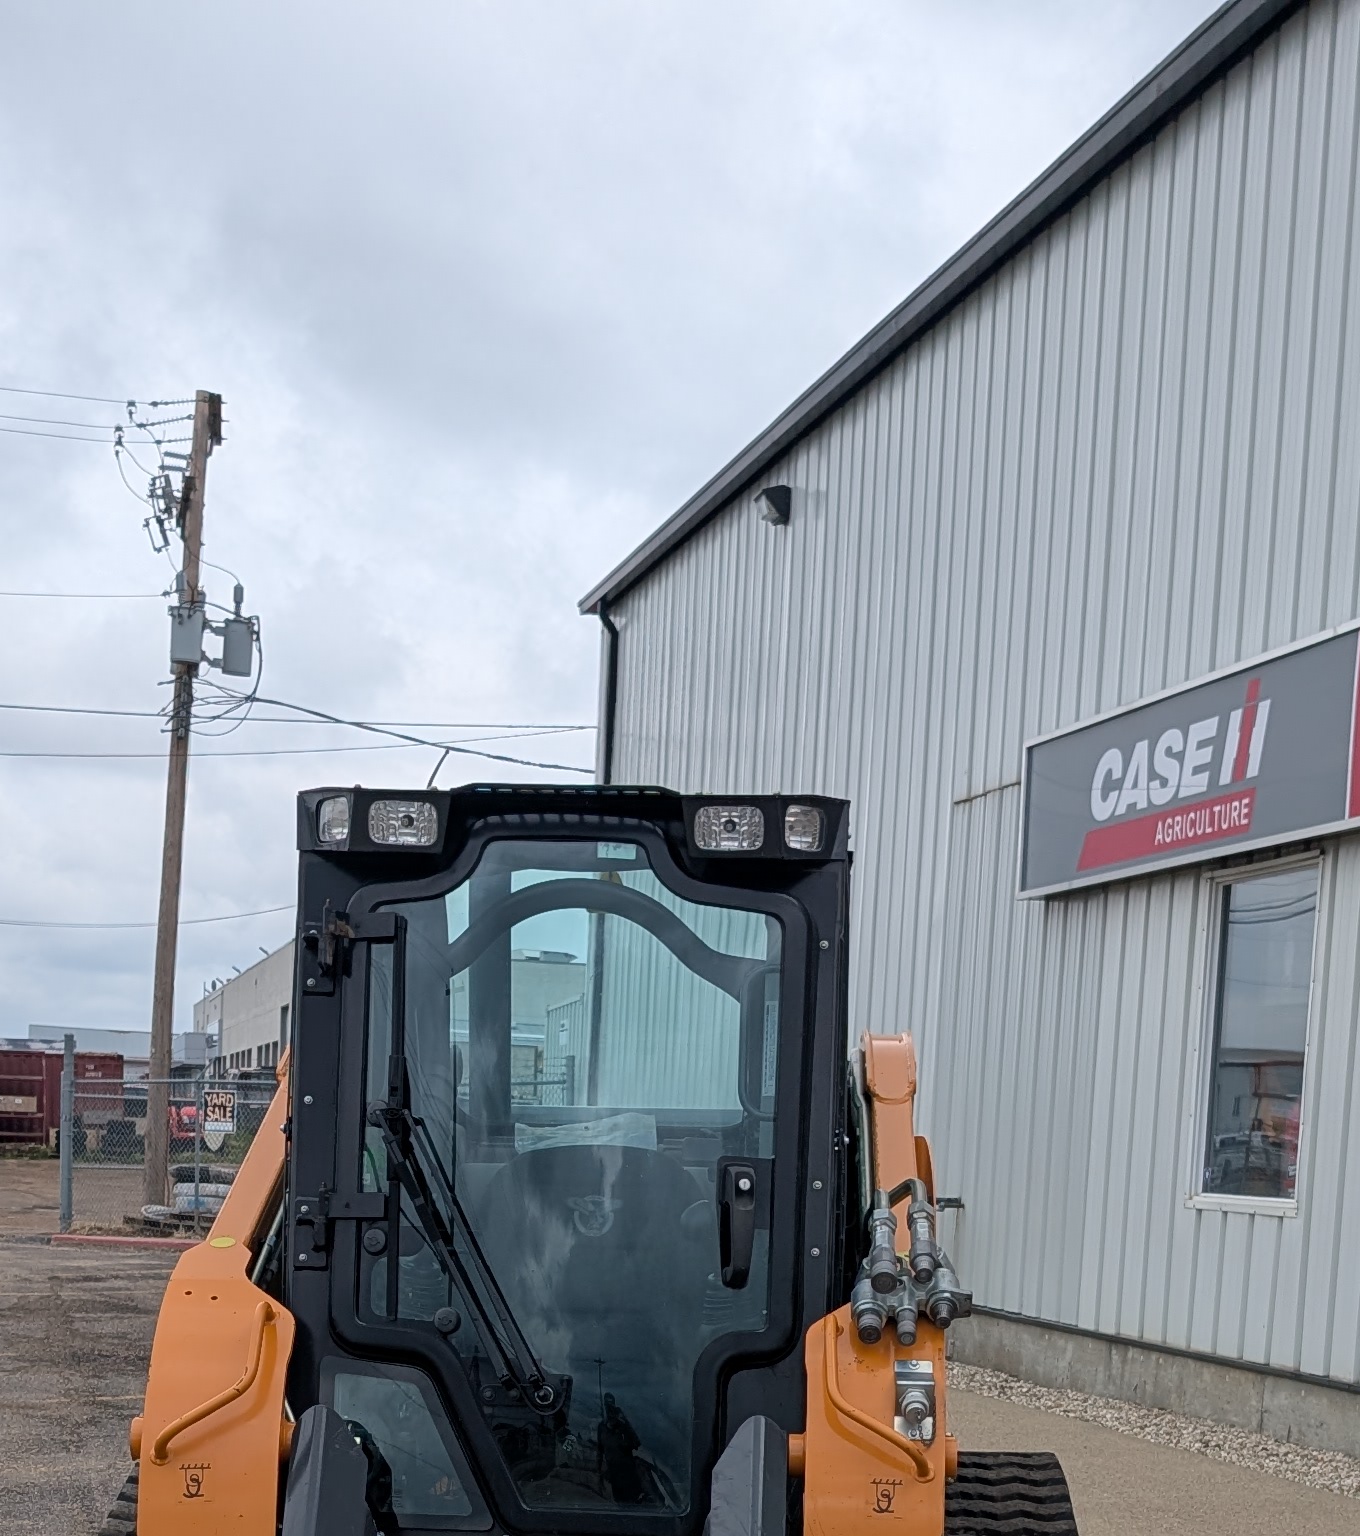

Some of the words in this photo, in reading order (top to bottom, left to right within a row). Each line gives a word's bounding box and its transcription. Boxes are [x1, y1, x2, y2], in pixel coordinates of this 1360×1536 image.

[1091, 716, 1220, 822] CASE
[1155, 797, 1251, 846] AGRICULTURE
[205, 1093, 234, 1107] YARD
[206, 1106, 233, 1122] SALE
